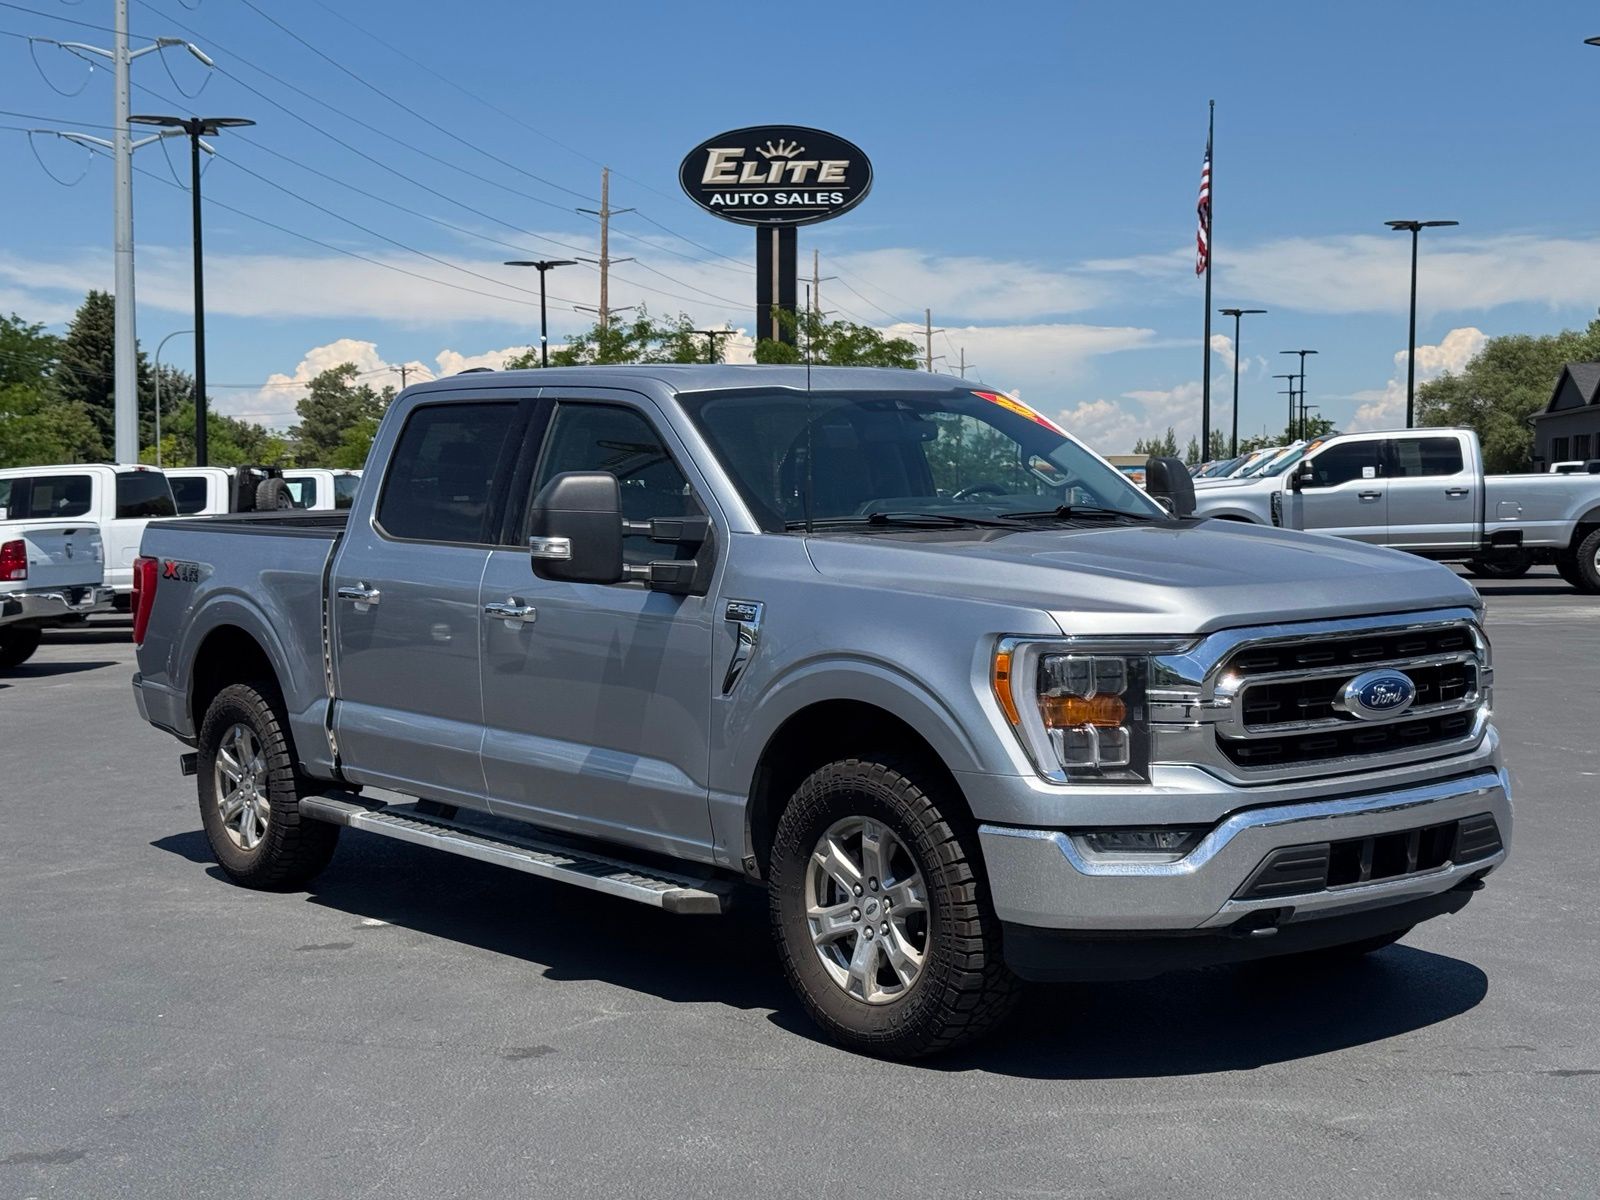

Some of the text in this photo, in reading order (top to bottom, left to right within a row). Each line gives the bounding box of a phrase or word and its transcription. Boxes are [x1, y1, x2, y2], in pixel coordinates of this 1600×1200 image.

[701, 147, 850, 184] ELITE
[709, 192, 844, 206] AUTO SALES
[163, 560, 199, 580] XTR
[1371, 683, 1403, 705] Ford
